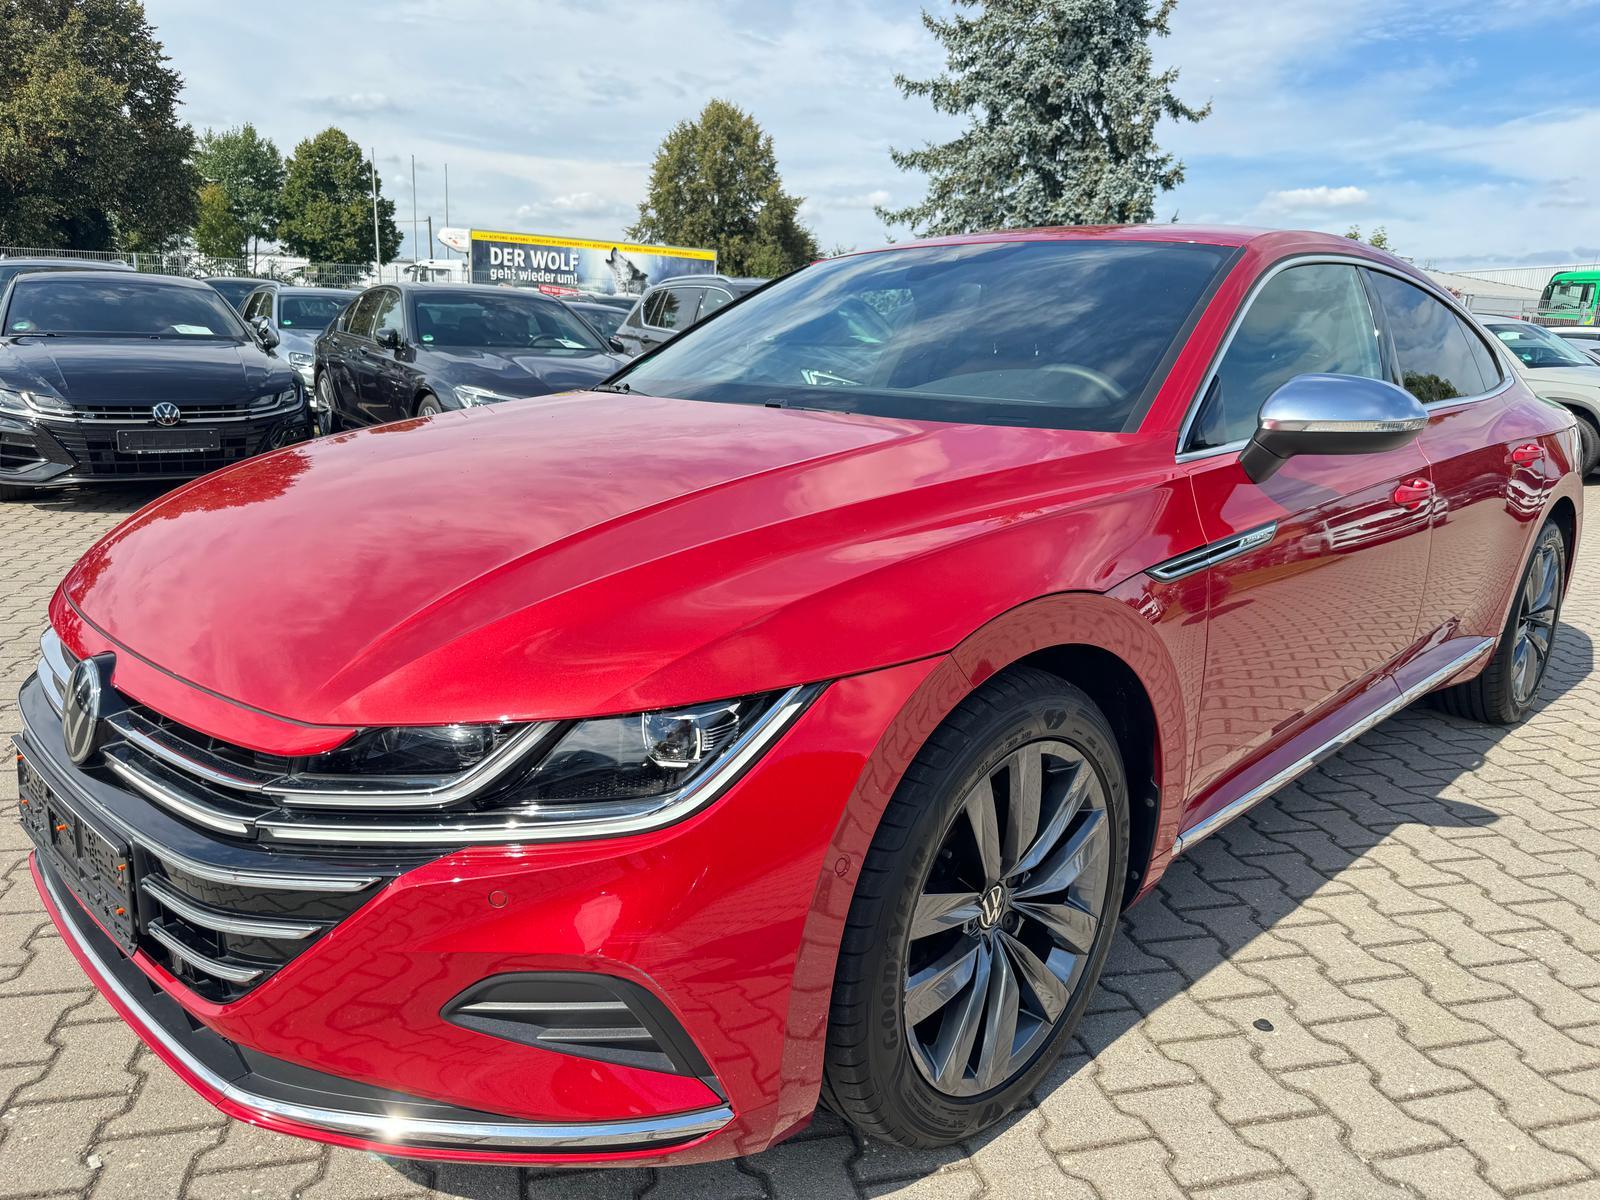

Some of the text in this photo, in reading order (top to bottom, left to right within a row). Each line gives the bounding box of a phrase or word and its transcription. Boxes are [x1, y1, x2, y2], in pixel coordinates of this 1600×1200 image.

[489, 246, 579, 271] DER WOLF
[490, 267, 578, 285] geht wieder um!
